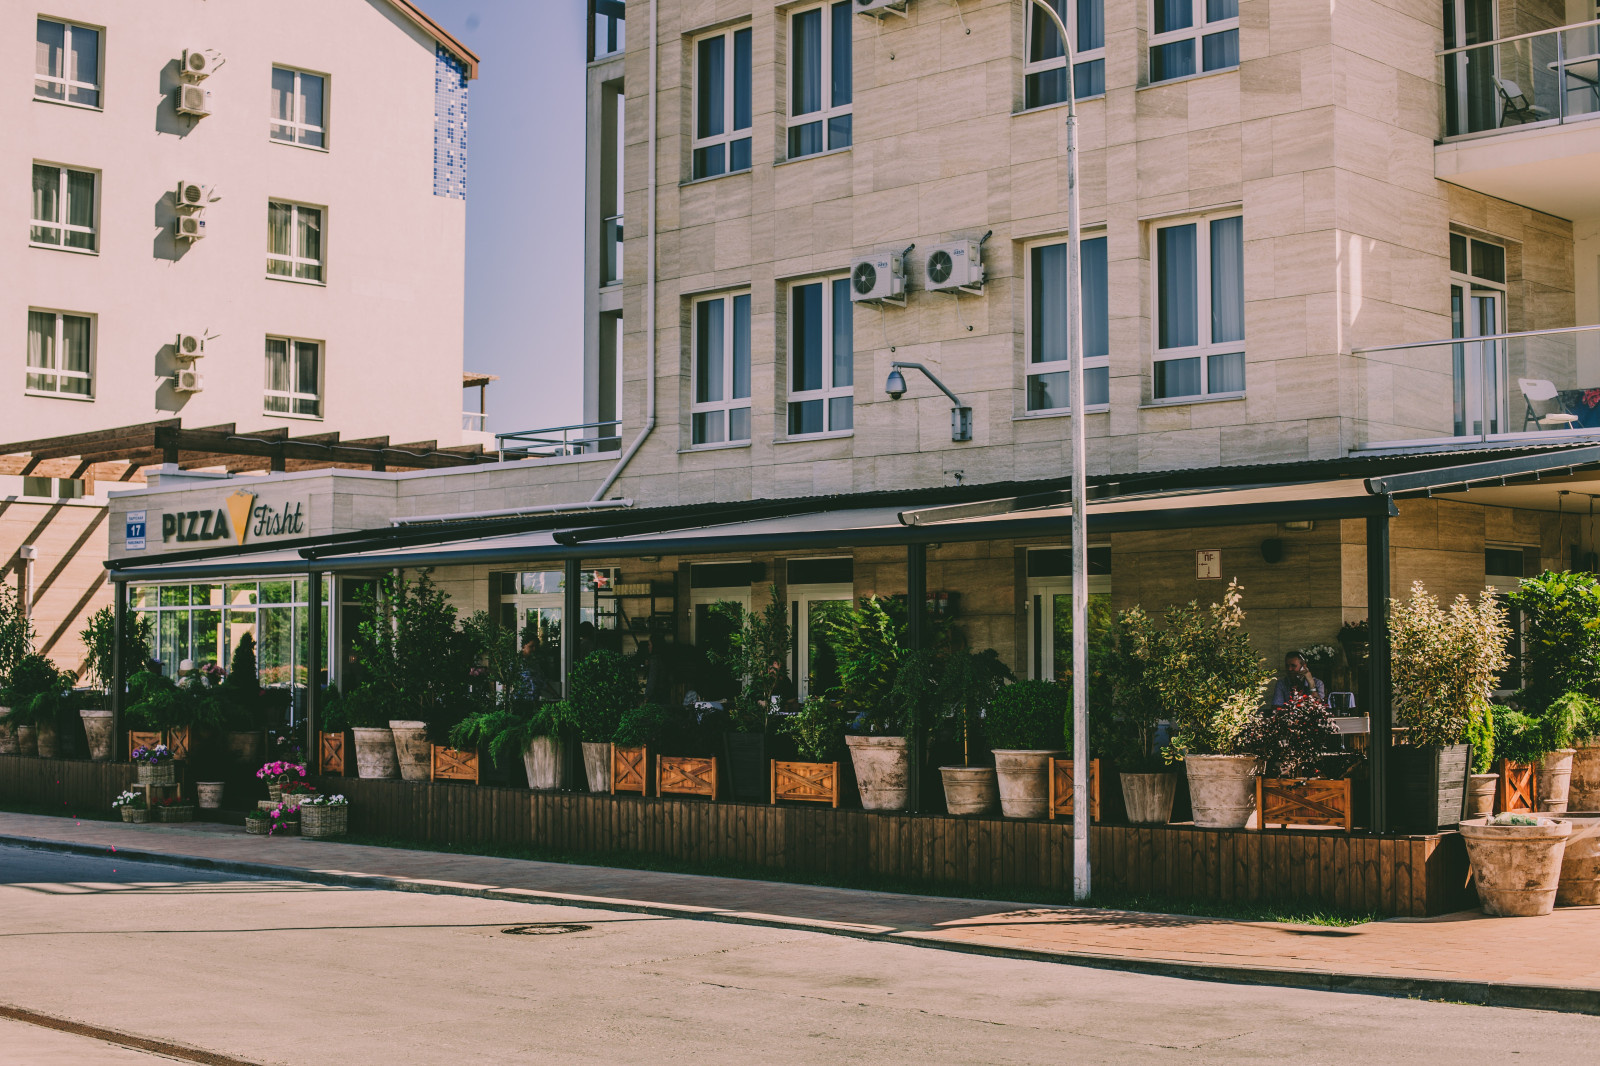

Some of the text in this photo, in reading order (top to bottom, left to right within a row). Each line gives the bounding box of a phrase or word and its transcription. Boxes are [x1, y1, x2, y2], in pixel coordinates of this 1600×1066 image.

[130, 524, 141, 537] 17
[162, 501, 304, 543] PIZZA Fisht
